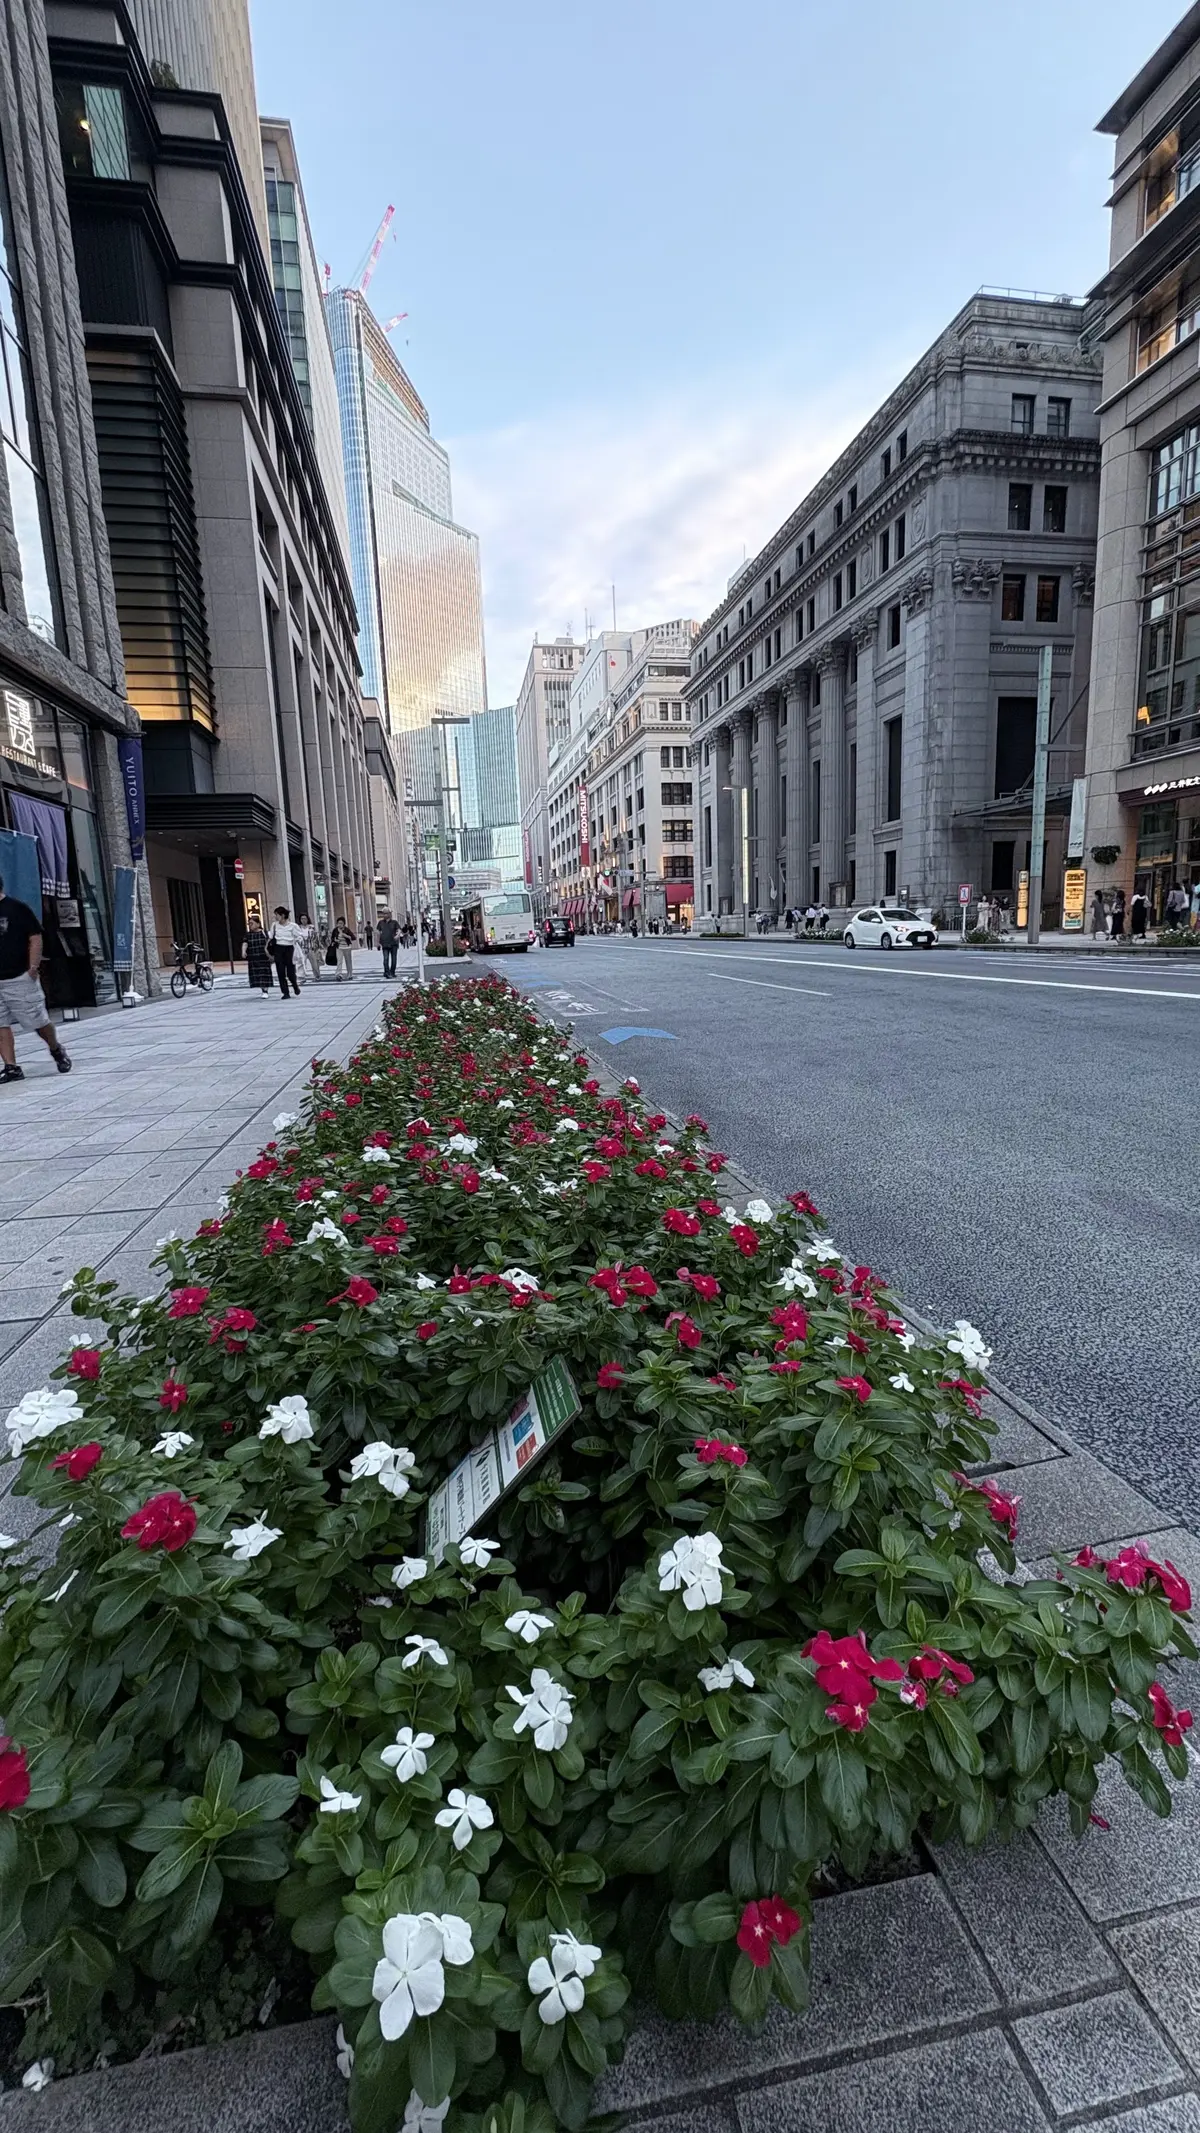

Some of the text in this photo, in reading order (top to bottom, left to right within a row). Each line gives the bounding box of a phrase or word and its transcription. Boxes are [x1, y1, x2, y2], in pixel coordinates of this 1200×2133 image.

[1, 745, 37, 769] RESTAURANT
[42, 762, 57, 778] CAFE
[125, 756, 140, 824] YUITO ANNEX
[580, 790, 588, 843] MITSUKOSHI
